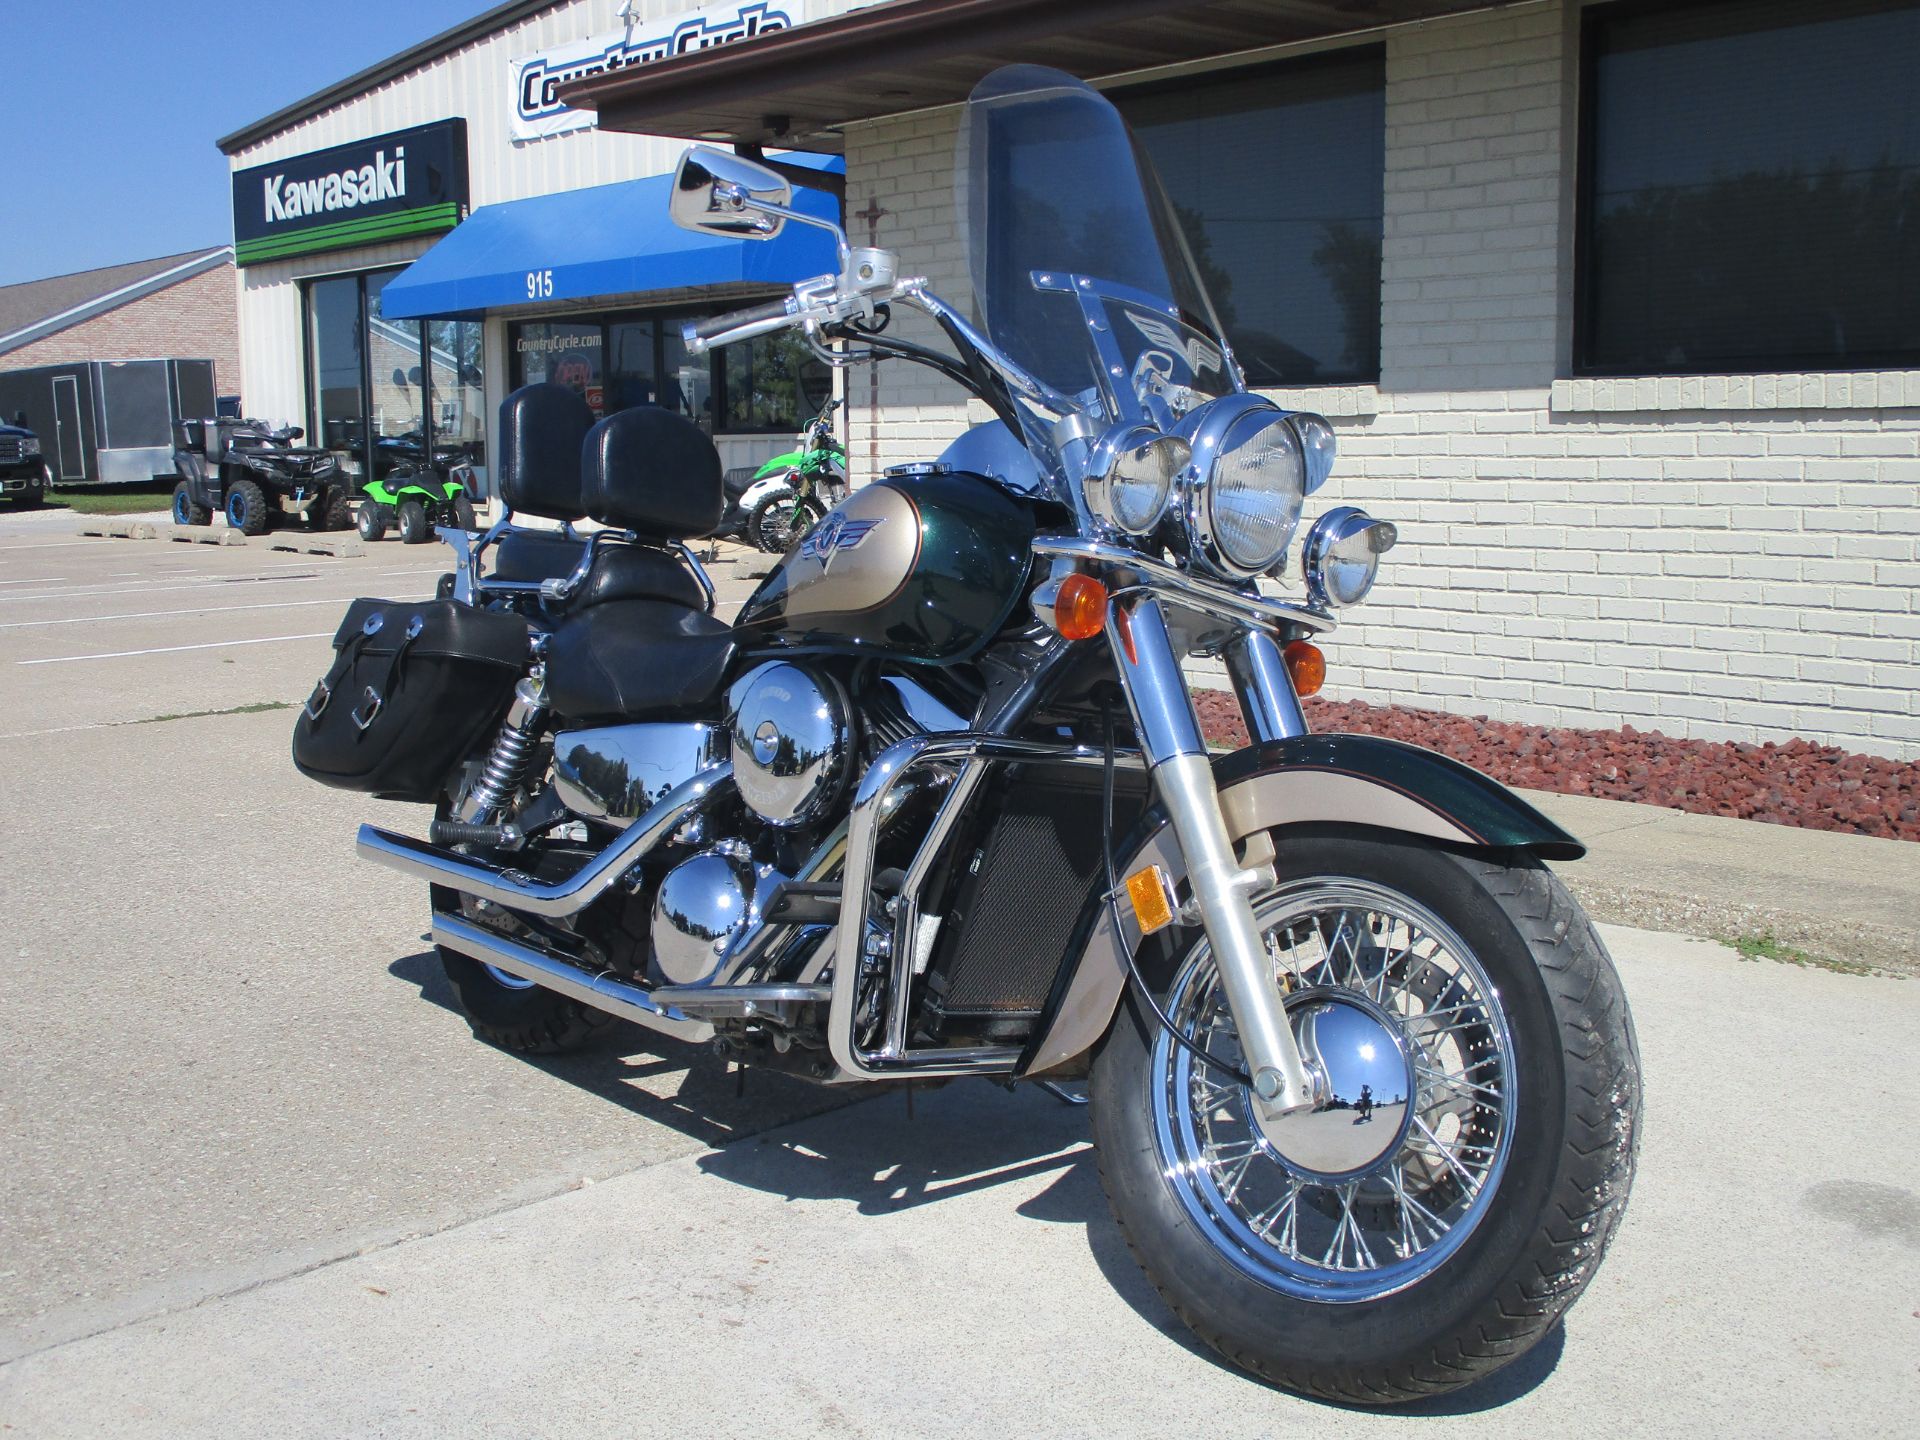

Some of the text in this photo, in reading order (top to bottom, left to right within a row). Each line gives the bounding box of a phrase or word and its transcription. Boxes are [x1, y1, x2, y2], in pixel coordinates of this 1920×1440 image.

[264, 146, 406, 223] Kawasaki
[527, 270, 553, 299] 915
[516, 334, 603, 354] CountryCycle.com
